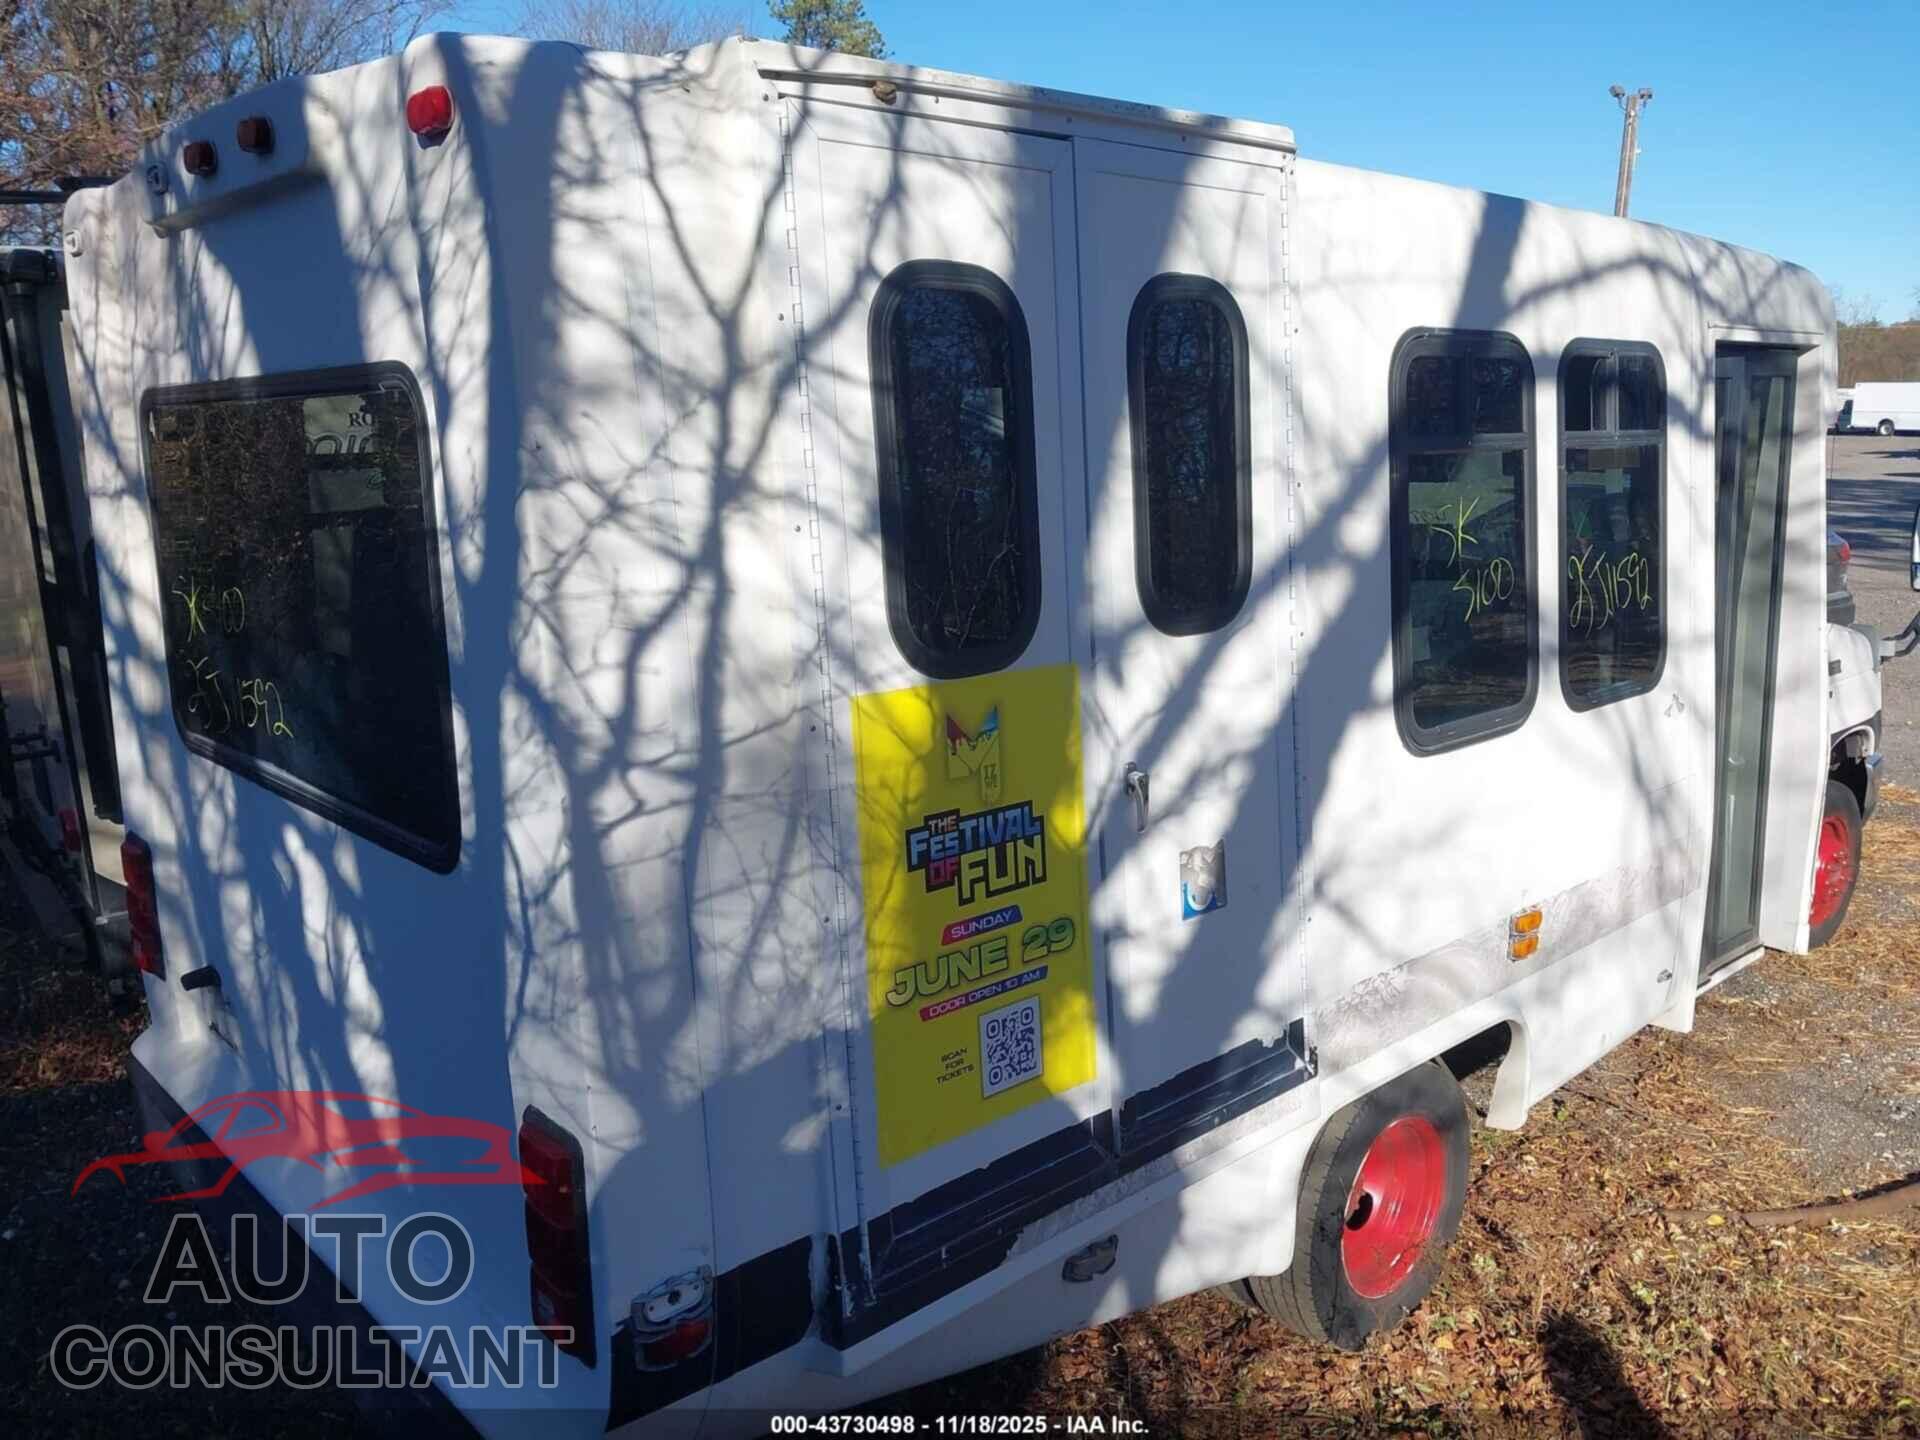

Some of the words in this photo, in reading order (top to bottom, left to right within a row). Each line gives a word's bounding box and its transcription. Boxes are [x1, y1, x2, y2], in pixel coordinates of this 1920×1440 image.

[909, 805, 1042, 867] FESTIVAL
[928, 814, 958, 833] THE
[928, 855, 960, 886] OF
[960, 834, 1044, 901] FUN
[950, 909, 1014, 939] SUNDAY
[885, 935, 1009, 1008] JUNE
[1022, 916, 1076, 964] 29
[928, 996, 966, 1018] DOOR
[968, 984, 1002, 1002] OPEN
[1005, 978, 1019, 991] 10
[1021, 970, 1041, 985] AM
[941, 1047, 968, 1063] SCAN
[944, 1057, 965, 1070] FOR
[936, 1063, 975, 1084] TICKETS
